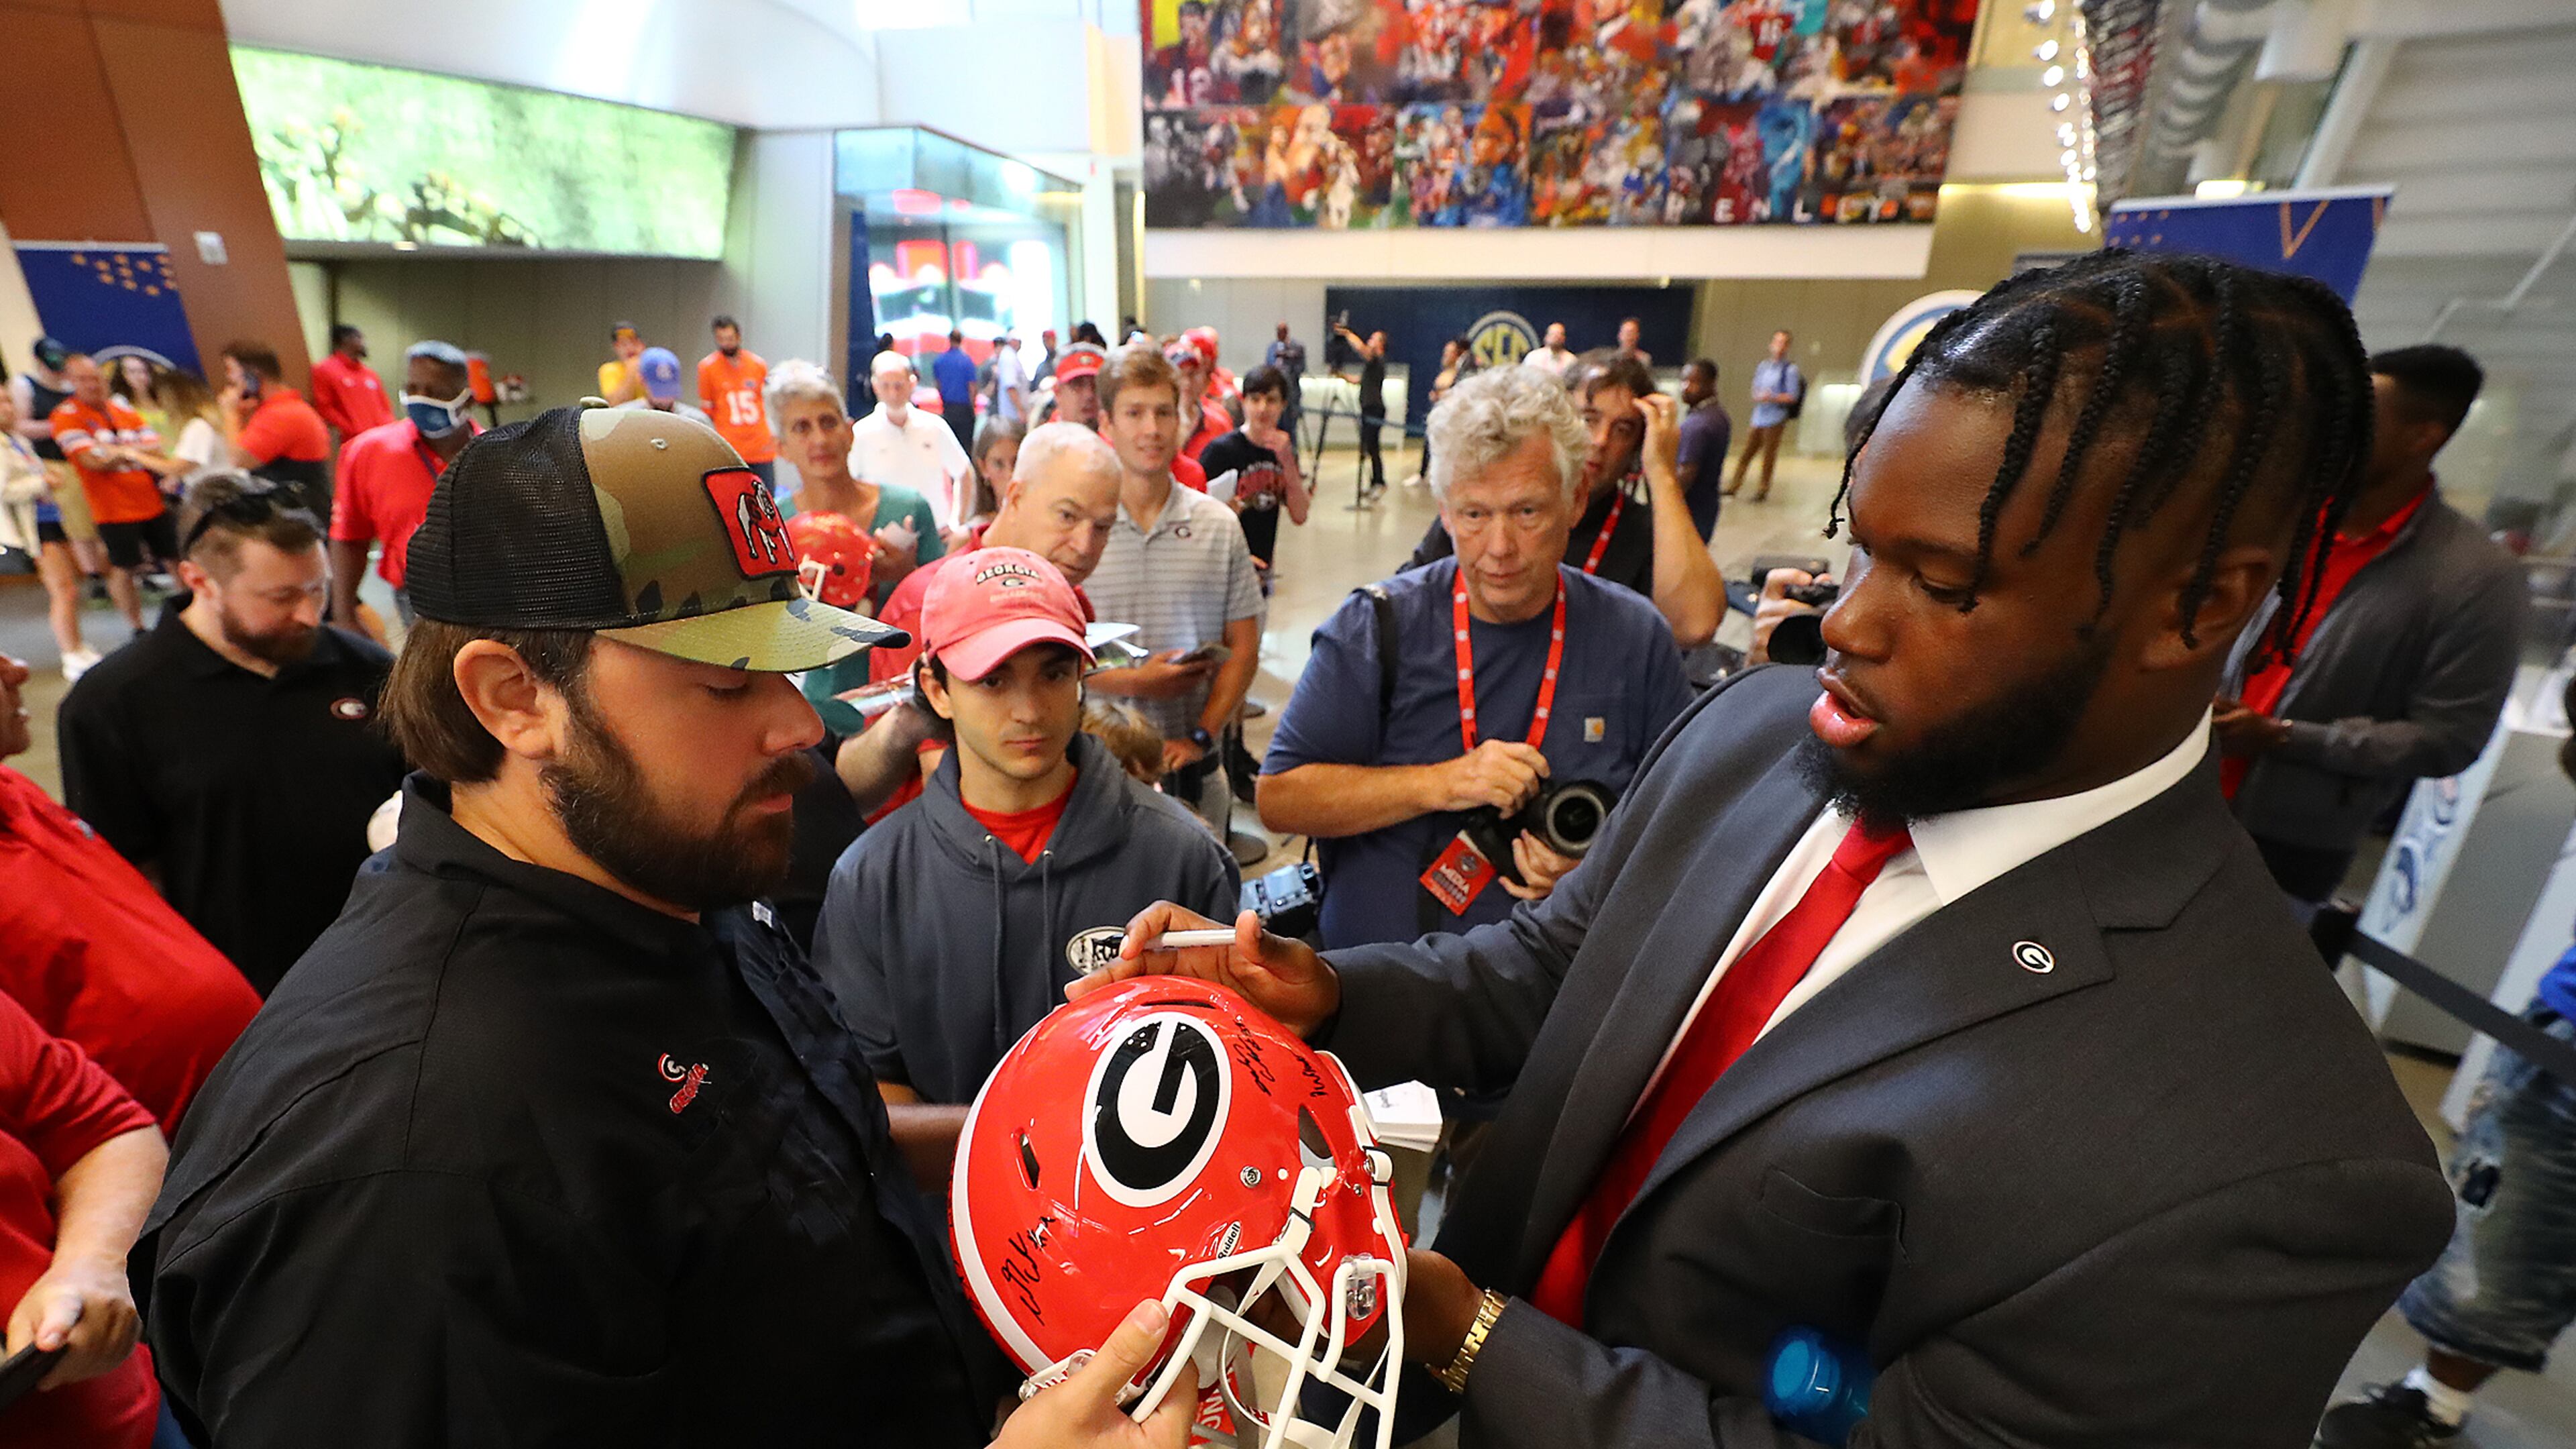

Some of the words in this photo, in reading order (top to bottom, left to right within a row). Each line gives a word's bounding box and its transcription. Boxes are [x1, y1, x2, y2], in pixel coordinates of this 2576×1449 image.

[1471, 323, 1530, 366] SEC
[727, 390, 759, 424] 15
[1439, 863, 1470, 894] MEDIA
[2015, 943, 2052, 971] G
[1093, 1019, 1222, 1192] G
[1217, 1223, 1241, 1259] Riddell
